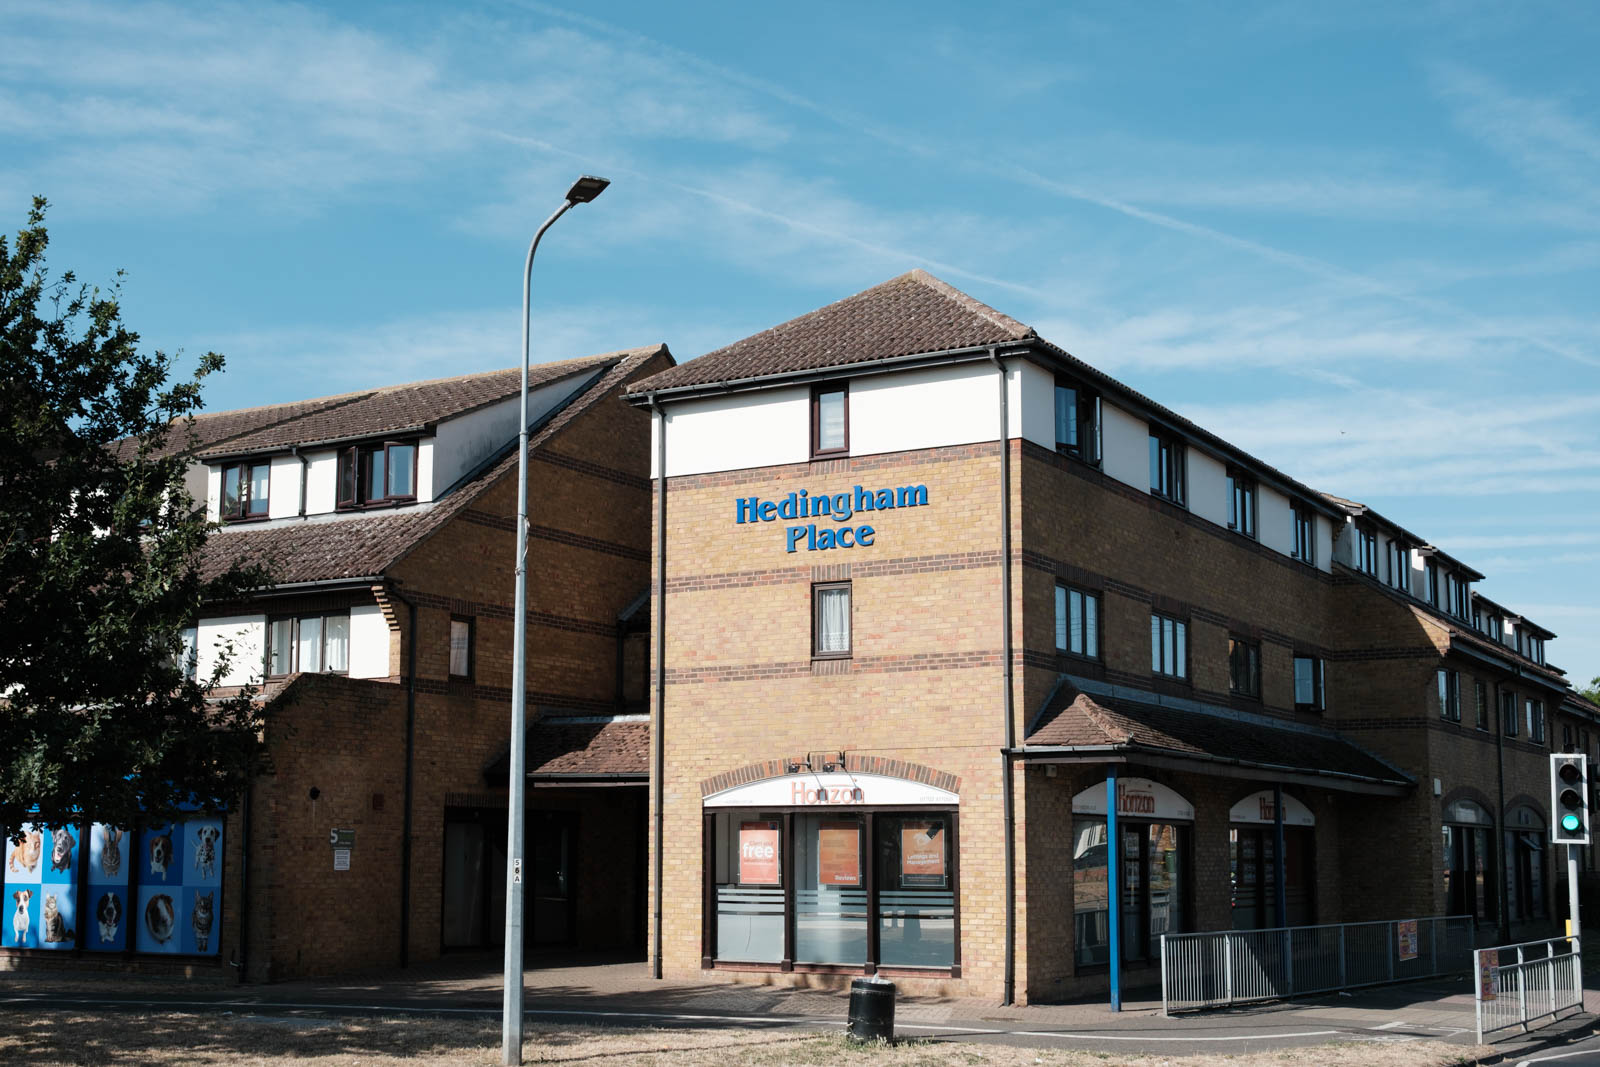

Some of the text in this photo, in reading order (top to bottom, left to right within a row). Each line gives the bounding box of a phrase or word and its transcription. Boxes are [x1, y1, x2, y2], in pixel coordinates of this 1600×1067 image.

[736, 484, 929, 523] Hedingham
[785, 524, 875, 553] Place
[330, 828, 338, 843] 5
[743, 842, 774, 859] free
